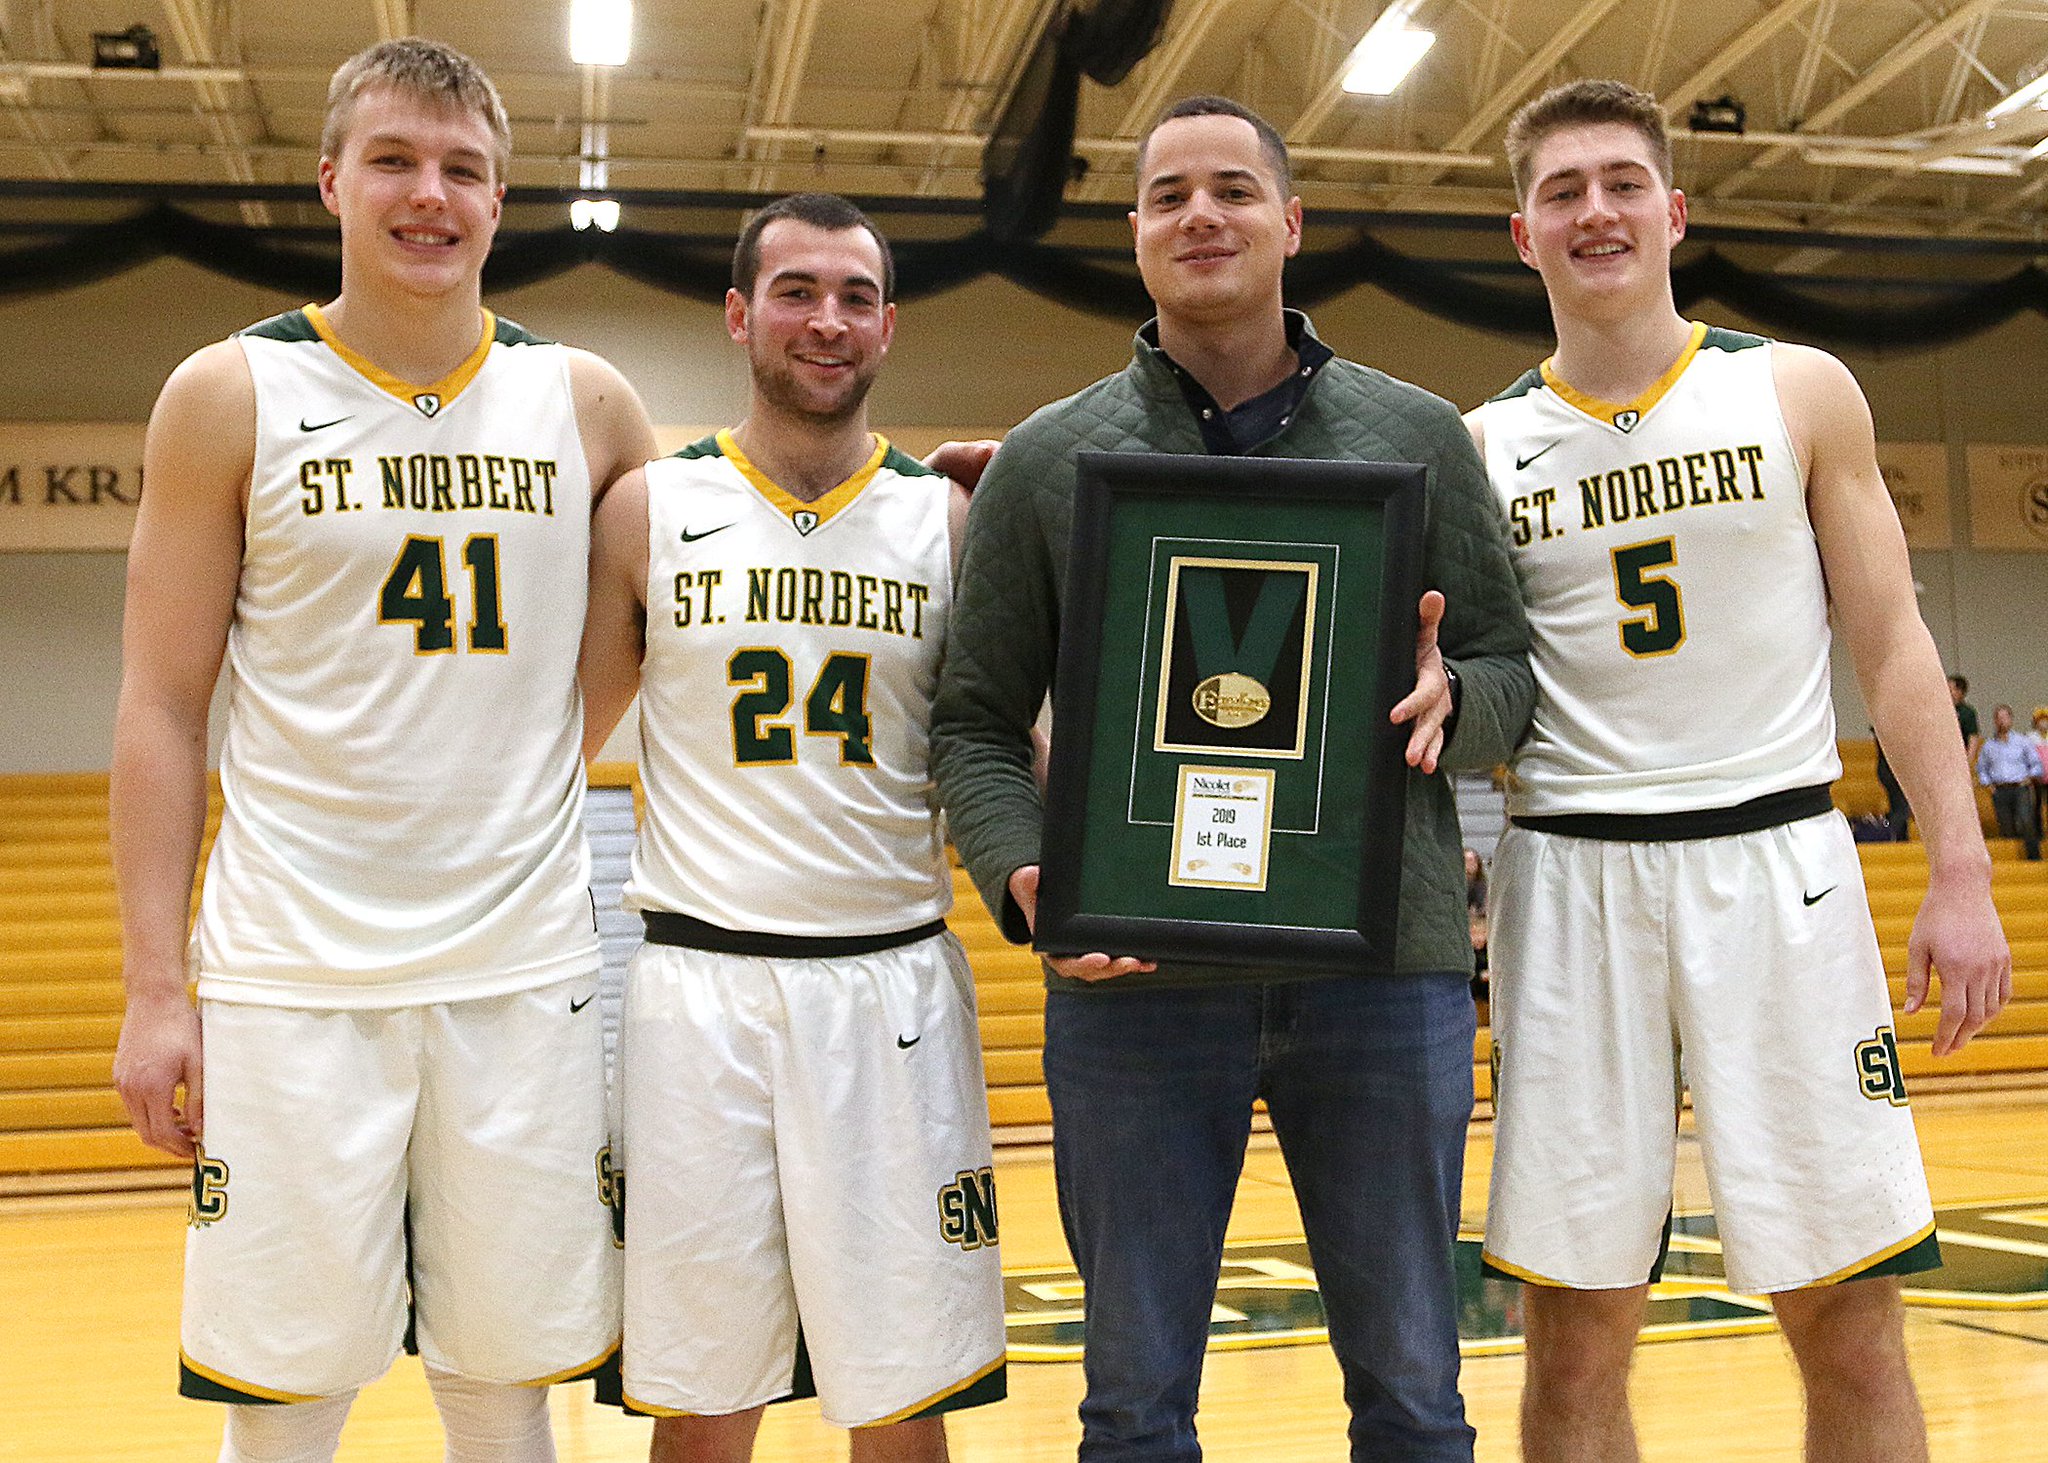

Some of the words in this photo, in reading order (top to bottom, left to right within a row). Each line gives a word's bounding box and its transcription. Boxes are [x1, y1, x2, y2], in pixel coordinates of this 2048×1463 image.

[45, 464, 144, 505] KR
[300, 455, 362, 516] ST.
[378, 453, 557, 516] NORBERT
[1510, 488, 1564, 547] ST.
[1577, 445, 1766, 532] NORBERT
[377, 532, 508, 656] 41
[673, 569, 725, 628] ST.
[745, 567, 929, 640] NORBERT
[1610, 535, 1687, 659] 5
[725, 645, 877, 769] 24
[1212, 807, 1236, 825] 2019
[1217, 832, 1247, 849] Place
[937, 1166, 998, 1252] SN
